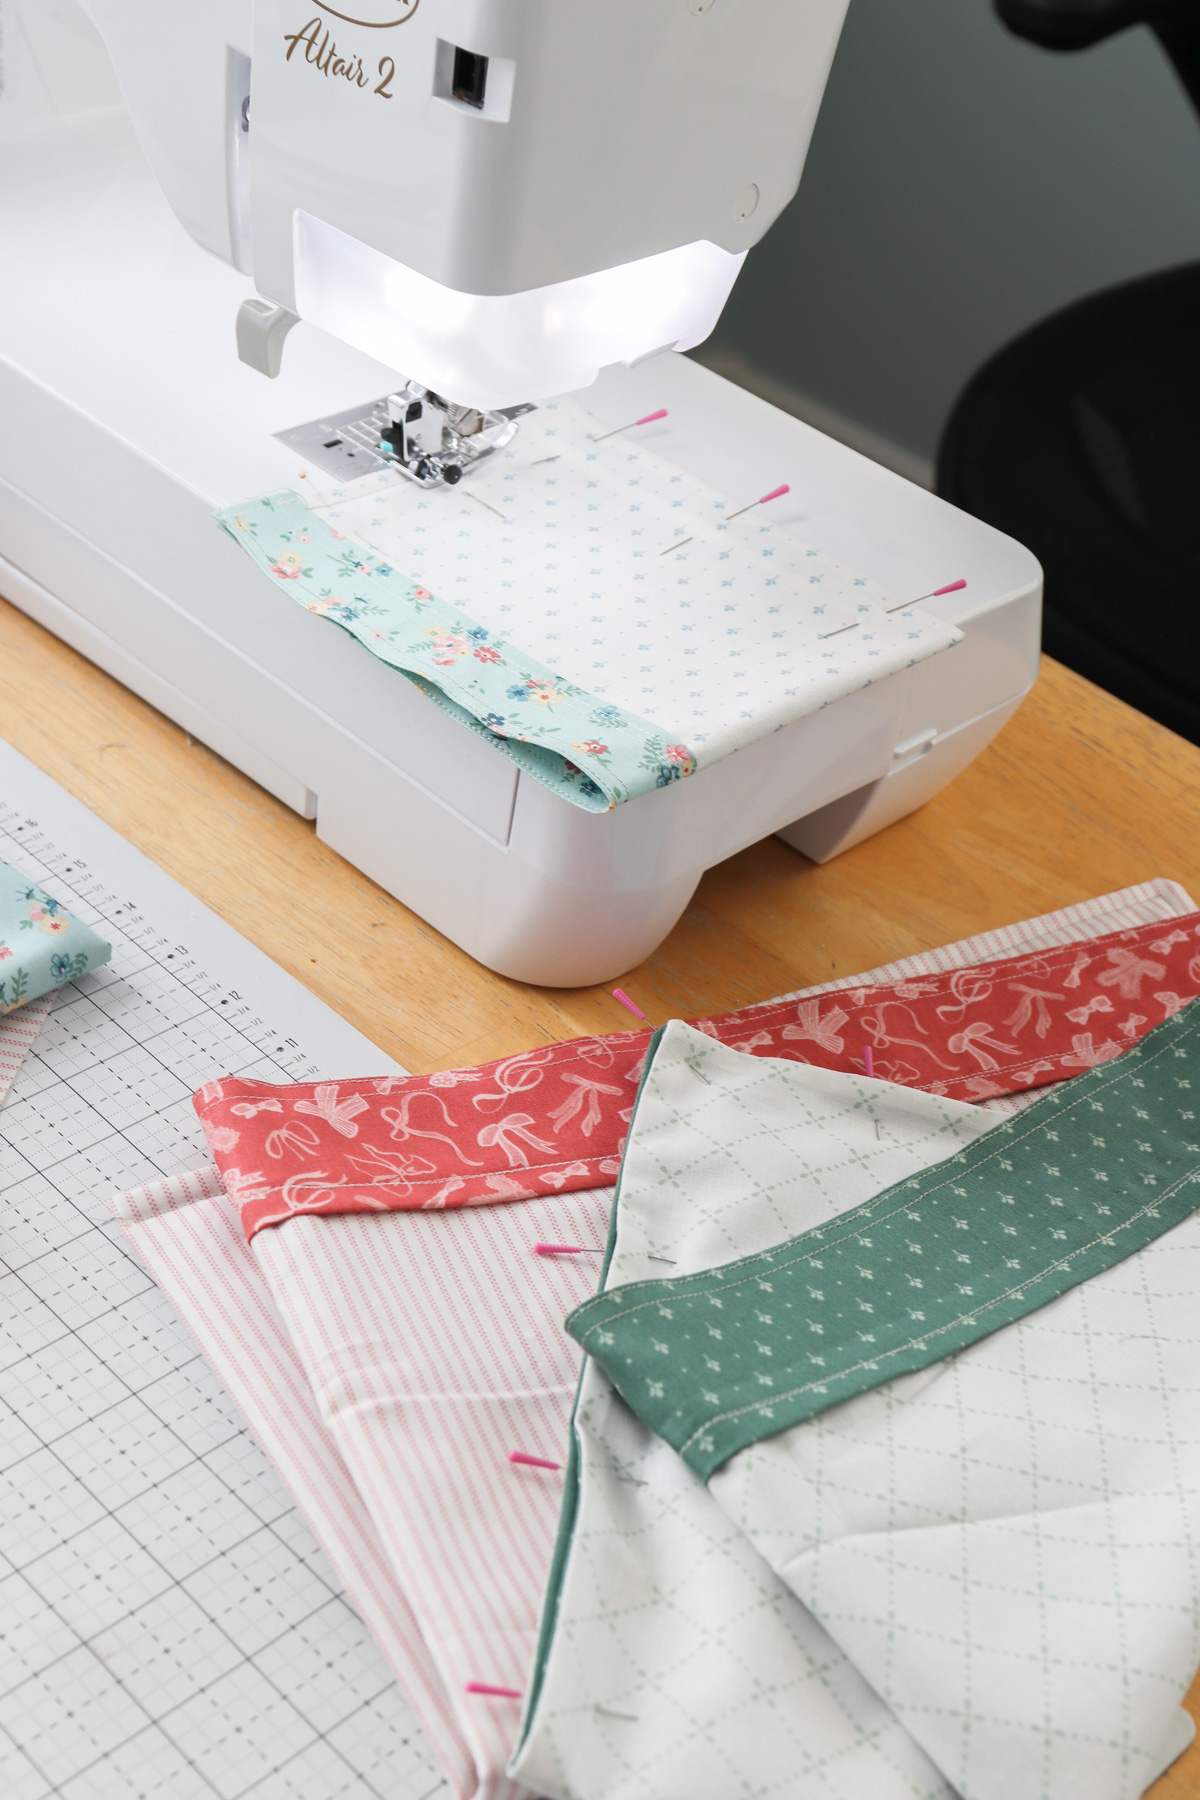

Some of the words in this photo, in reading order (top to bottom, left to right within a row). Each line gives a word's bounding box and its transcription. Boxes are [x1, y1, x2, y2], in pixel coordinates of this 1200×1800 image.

[284, 17, 369, 88] Altair
[374, 56, 395, 99] 2
[73, 859, 87, 869] 15
[123, 901, 137, 911] 14
[174, 945, 189, 956] 13
[195, 971, 208, 980] 1/2
[228, 990, 243, 1001] 12
[250, 1017, 264, 1026] 1/2
[264, 1029, 278, 1038] 1/4
[285, 1037, 299, 1048] 11
[292, 1052, 307, 1063] 3/4
[306, 1065, 321, 1075] 1/2
